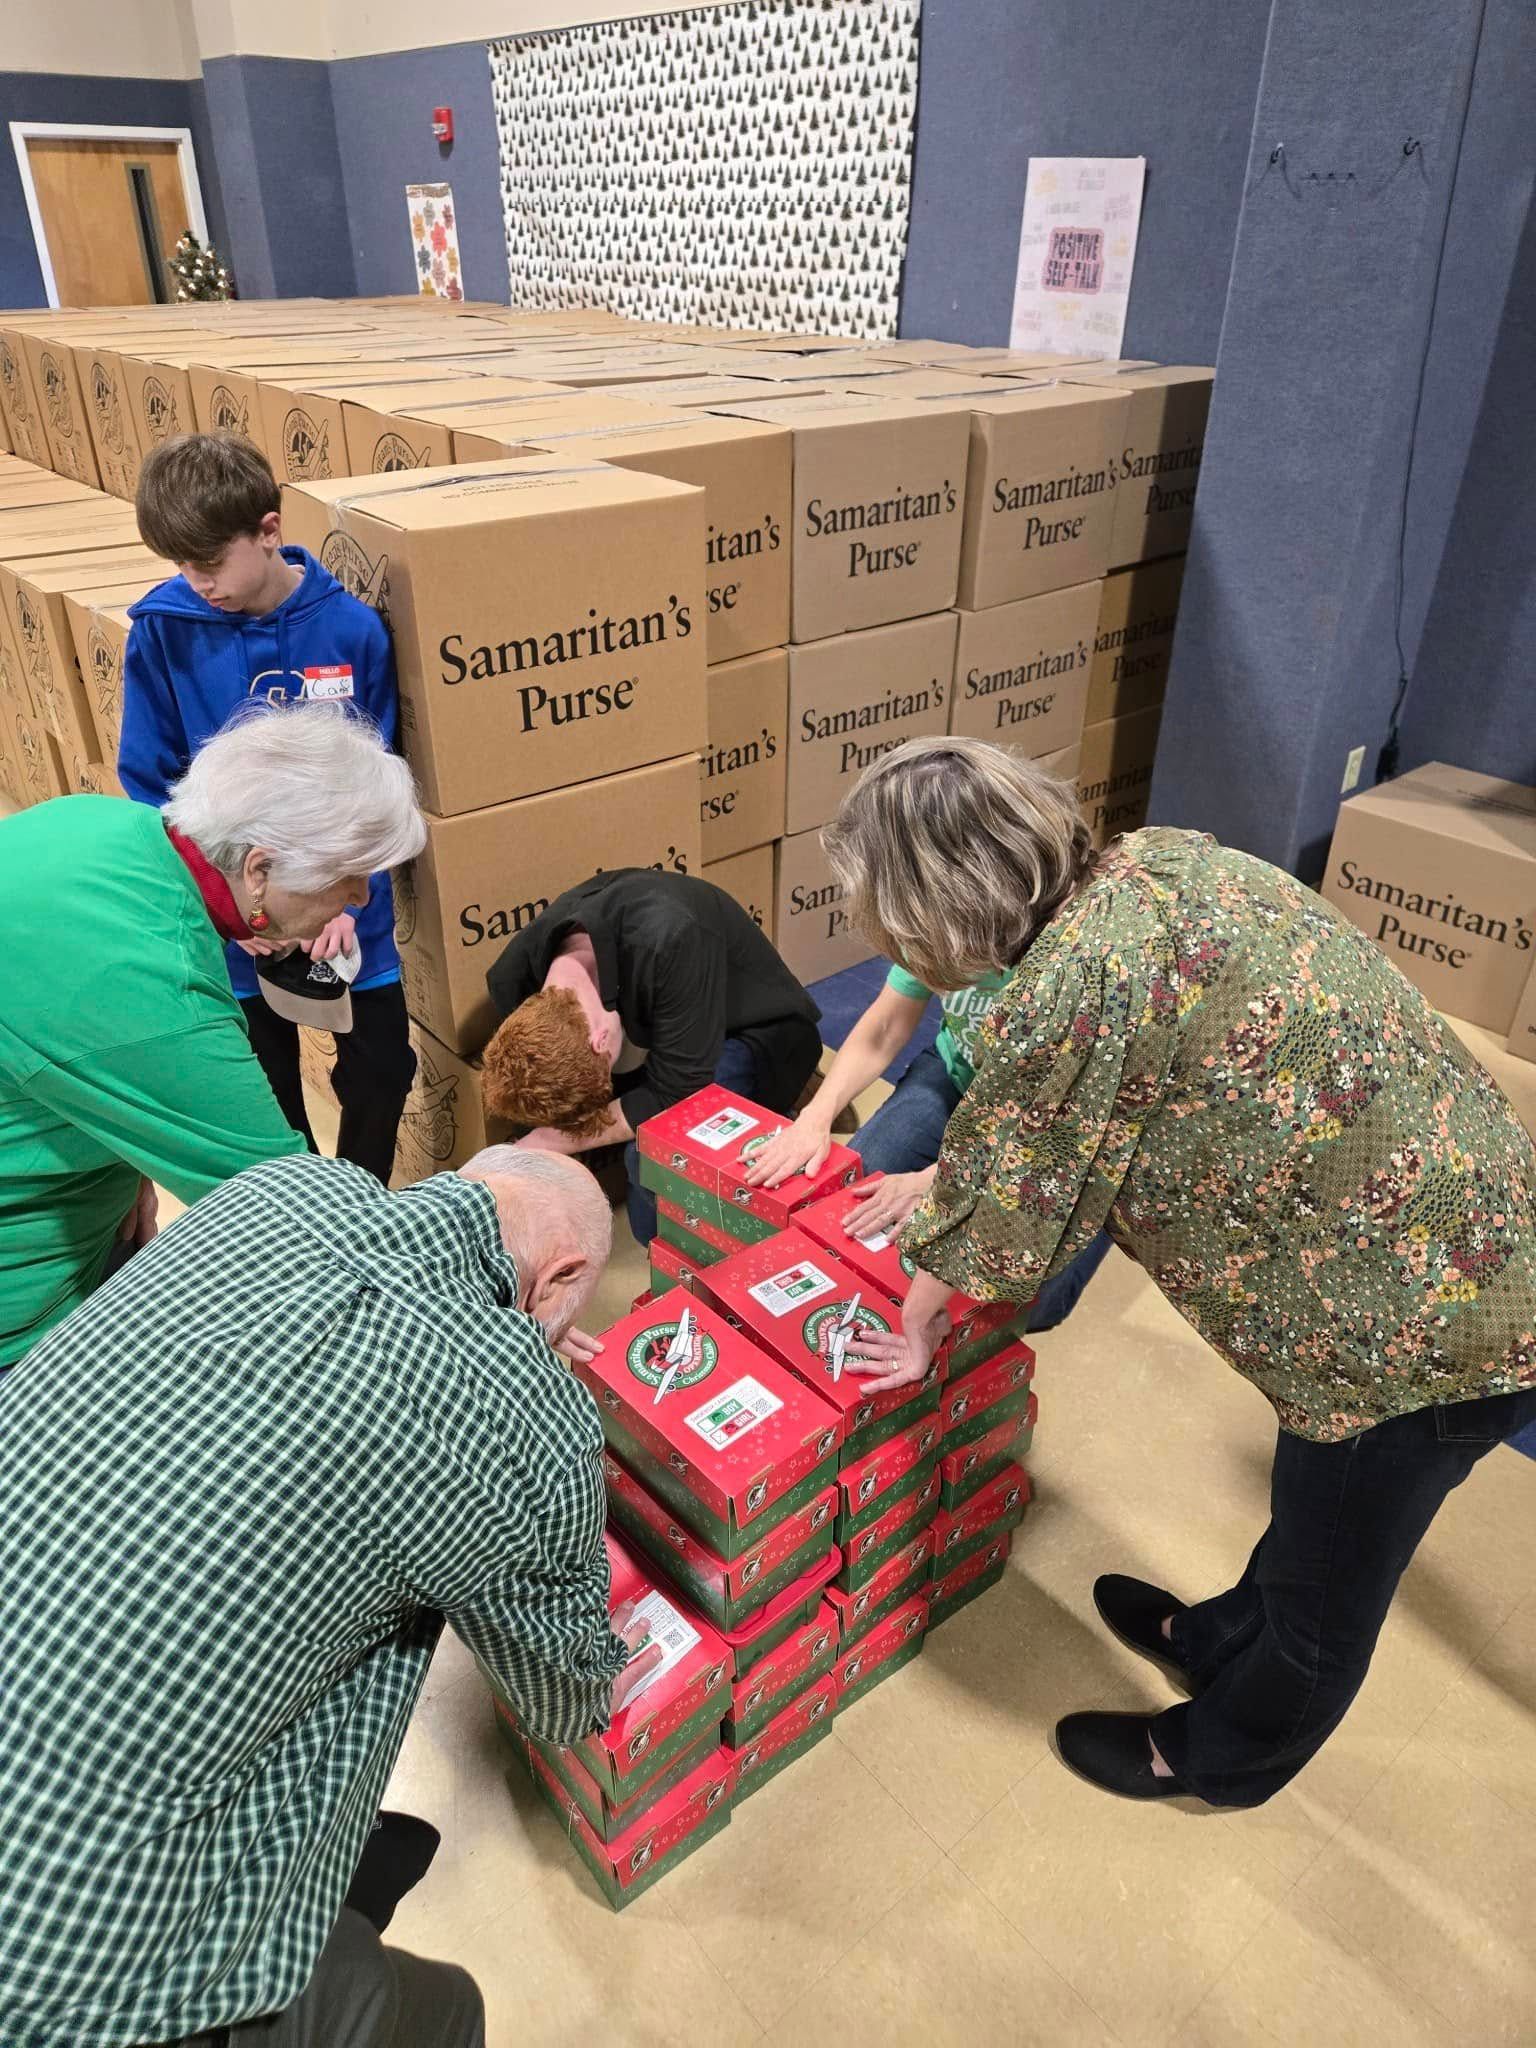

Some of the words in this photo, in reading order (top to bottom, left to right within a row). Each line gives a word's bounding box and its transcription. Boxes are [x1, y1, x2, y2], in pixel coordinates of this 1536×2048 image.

[1053, 232, 1099, 260] POSITIVE
[1046, 260, 1100, 288] SELF-TALK
[806, 480, 957, 537] Samaritan's
[993, 459, 1118, 514] Samaritan's
[706, 515, 780, 565] itan's
[439, 594, 692, 685] Samaritan's
[965, 640, 1089, 700] Samaritan's
[801, 678, 944, 743] Samaritan's
[1337, 861, 1533, 950] Samaritan's
[642, 1325, 677, 1340] Purse
[631, 1338, 661, 1386] Samaritan's
[682, 1360, 714, 1386] Christmas
[703, 1343, 716, 1359] Child
[722, 1400, 739, 1416] BOY
[734, 1411, 754, 1427] GIRL
